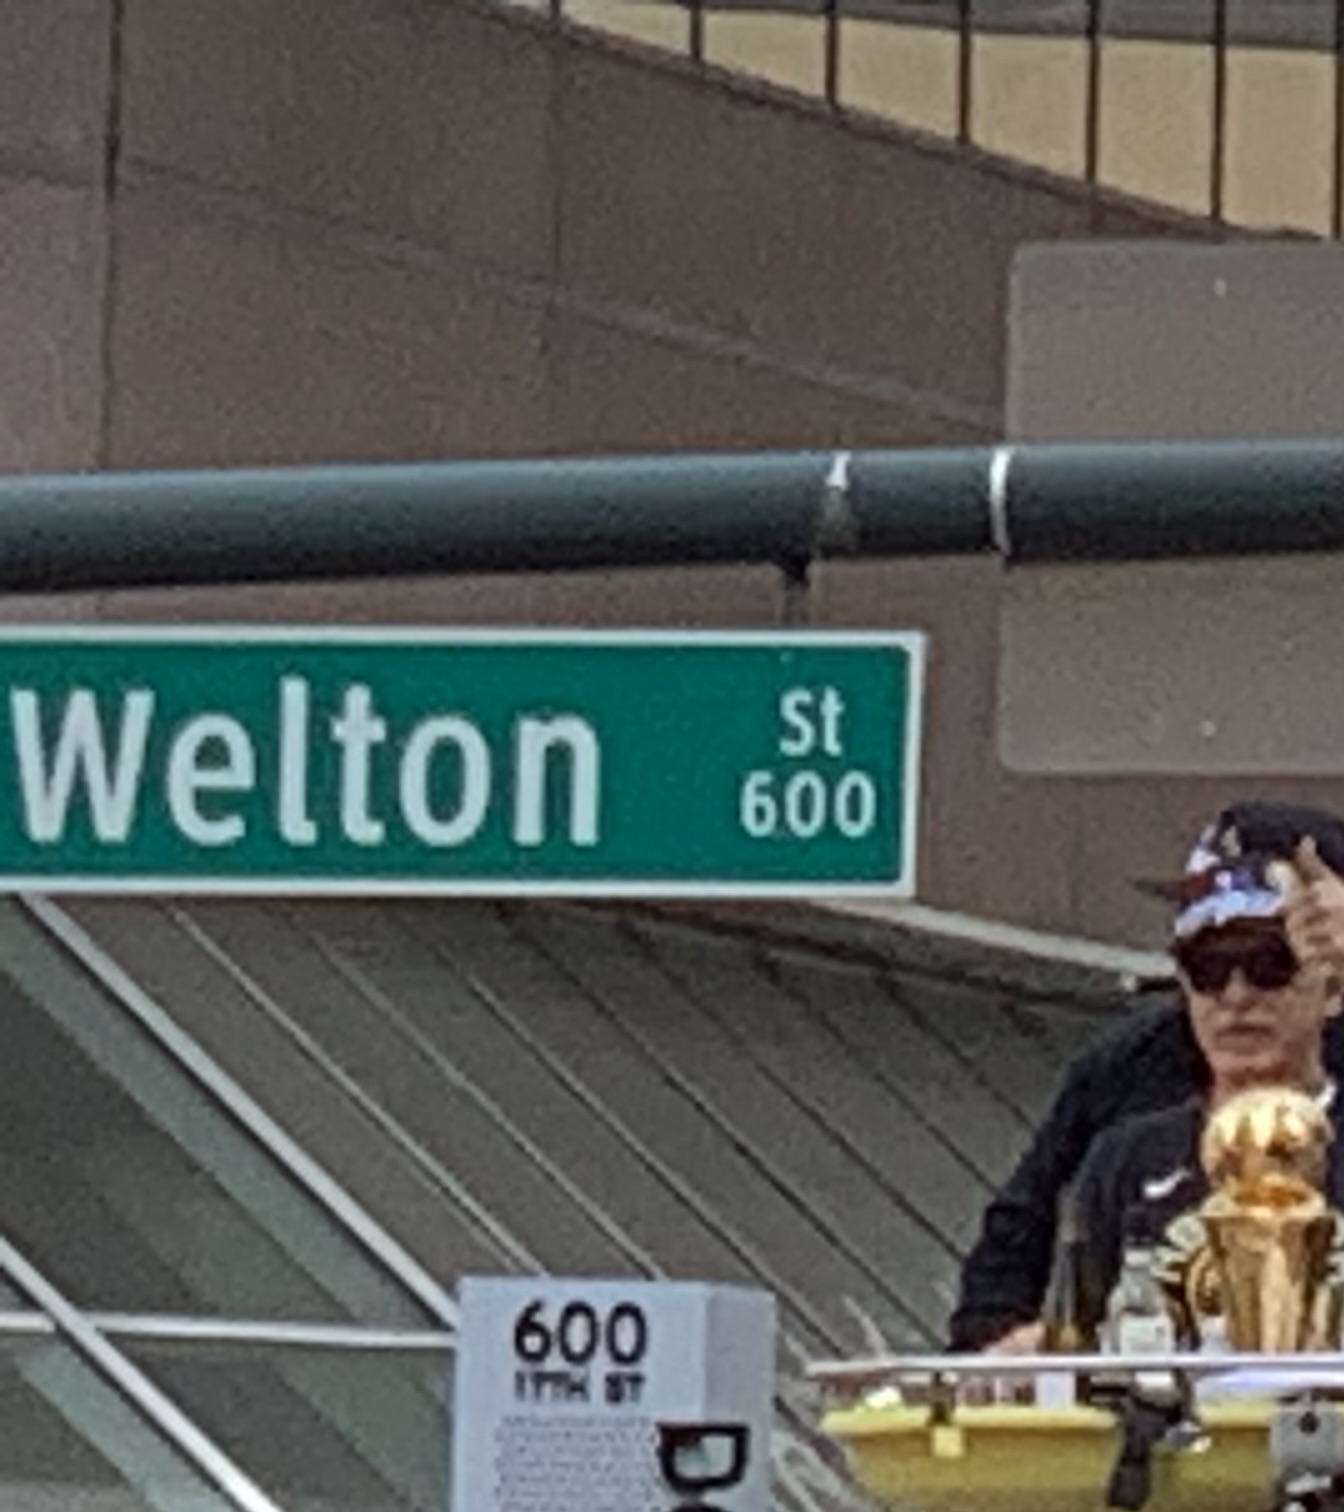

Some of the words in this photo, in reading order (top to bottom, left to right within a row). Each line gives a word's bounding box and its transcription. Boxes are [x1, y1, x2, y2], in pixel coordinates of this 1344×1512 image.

[778, 687, 845, 757] St
[9, 675, 601, 847] Welton
[738, 770, 877, 839] 600
[513, 1299, 649, 1366] 600
[604, 1371, 646, 1406] ST
